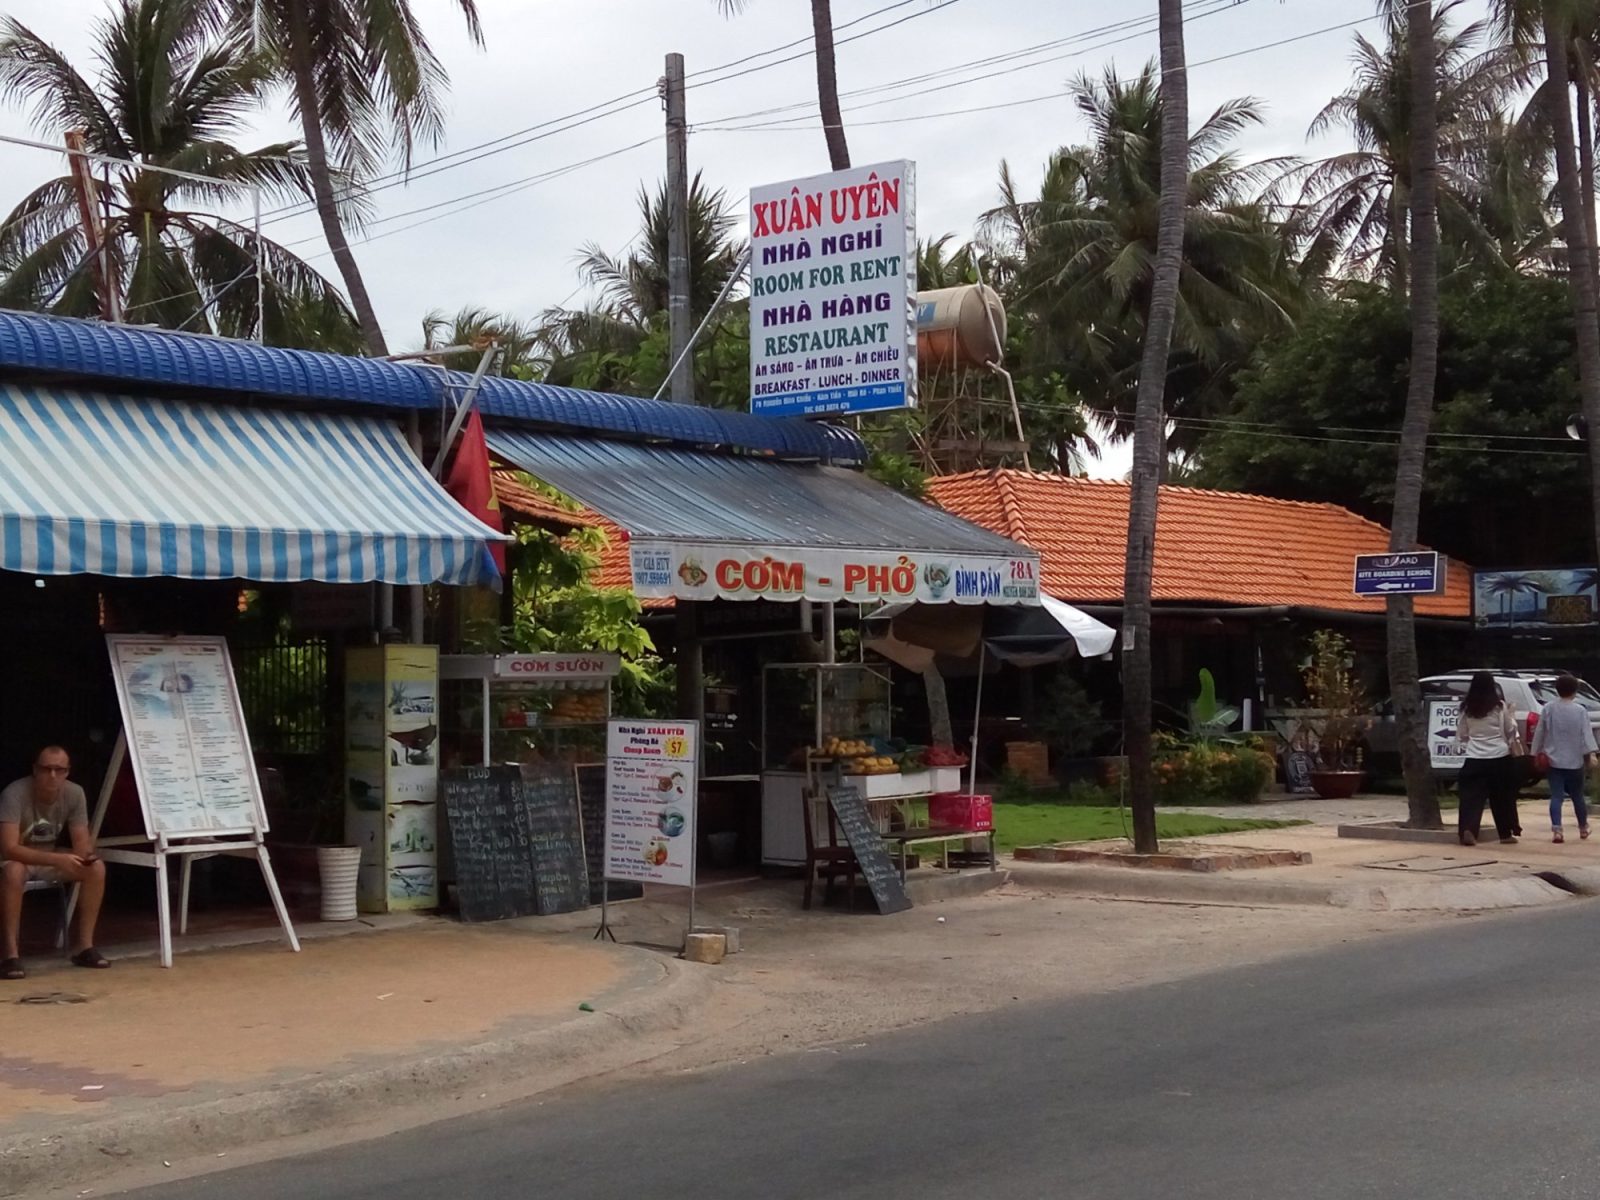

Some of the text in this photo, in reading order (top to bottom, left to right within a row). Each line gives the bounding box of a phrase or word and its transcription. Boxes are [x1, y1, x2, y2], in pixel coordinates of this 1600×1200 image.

[753, 172, 900, 238] XUÂN UYÊN
[763, 223, 882, 265] NHÀ NGHỈ
[753, 256, 900, 296] ROOM FOR RENT
[763, 292, 891, 327] NHÀ HÀNG
[765, 322, 889, 357] RESTAURANT
[755, 378, 811, 396] BREAKFAST
[818, 373, 853, 388] LUNCH
[861, 368, 900, 384] DINNER
[770, 360, 794, 375] SÁNG
[715, 556, 805, 592] CƠM
[844, 555, 918, 594] PHỞ
[956, 565, 978, 597] BÌNH
[1010, 561, 1033, 580] 78A
[1373, 570, 1405, 578] BOARDING
[1406, 569, 1432, 577] SCHOOL
[510, 658, 605, 672] CƠM SƯỜN
